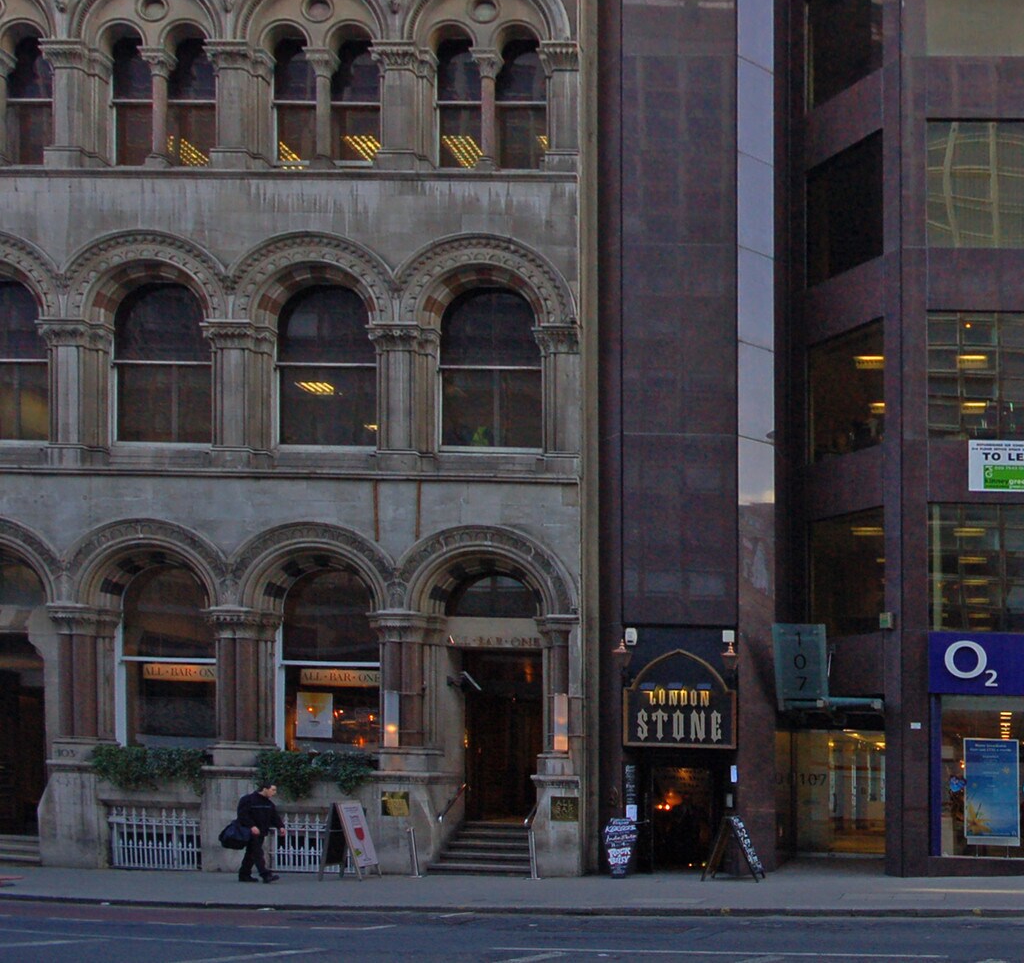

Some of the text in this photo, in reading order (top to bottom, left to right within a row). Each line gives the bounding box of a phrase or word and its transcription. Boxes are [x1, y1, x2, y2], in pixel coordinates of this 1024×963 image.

[982, 452, 1001, 461] TO
[511, 637, 541, 647] ONE
[145, 667, 215, 678] ALL BAR ON
[302, 671, 380, 683] ALL BAR ONE
[649, 689, 710, 707] LONDON
[637, 708, 722, 743] STONE
[800, 773, 827, 786] 107
